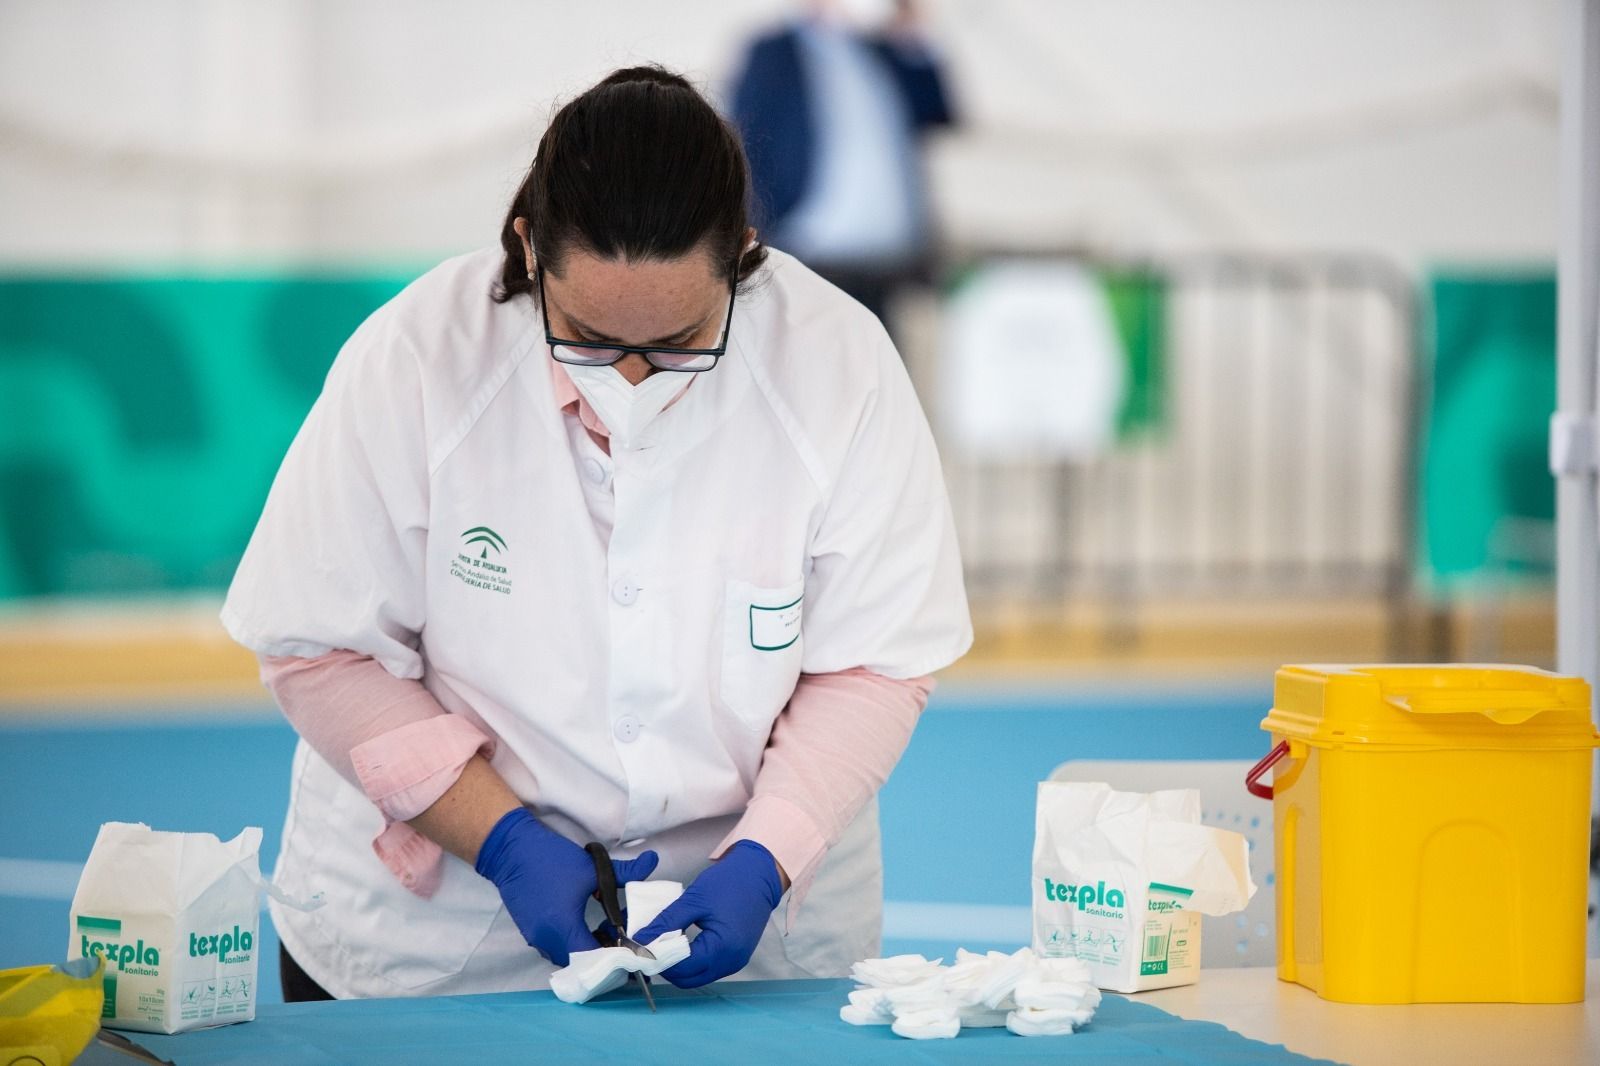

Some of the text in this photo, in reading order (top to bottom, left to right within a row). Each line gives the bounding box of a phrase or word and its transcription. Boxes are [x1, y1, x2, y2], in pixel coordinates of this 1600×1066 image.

[473, 559, 481, 567] DE
[483, 582, 491, 590] DE
[493, 584, 511, 595] SALUD
[1044, 878, 1125, 911] texpla
[1086, 907, 1124, 920] sanitario
[189, 925, 253, 962] texpla
[82, 935, 159, 970] texpla
[225, 954, 250, 965] sanitario
[125, 967, 159, 977] sanitario
